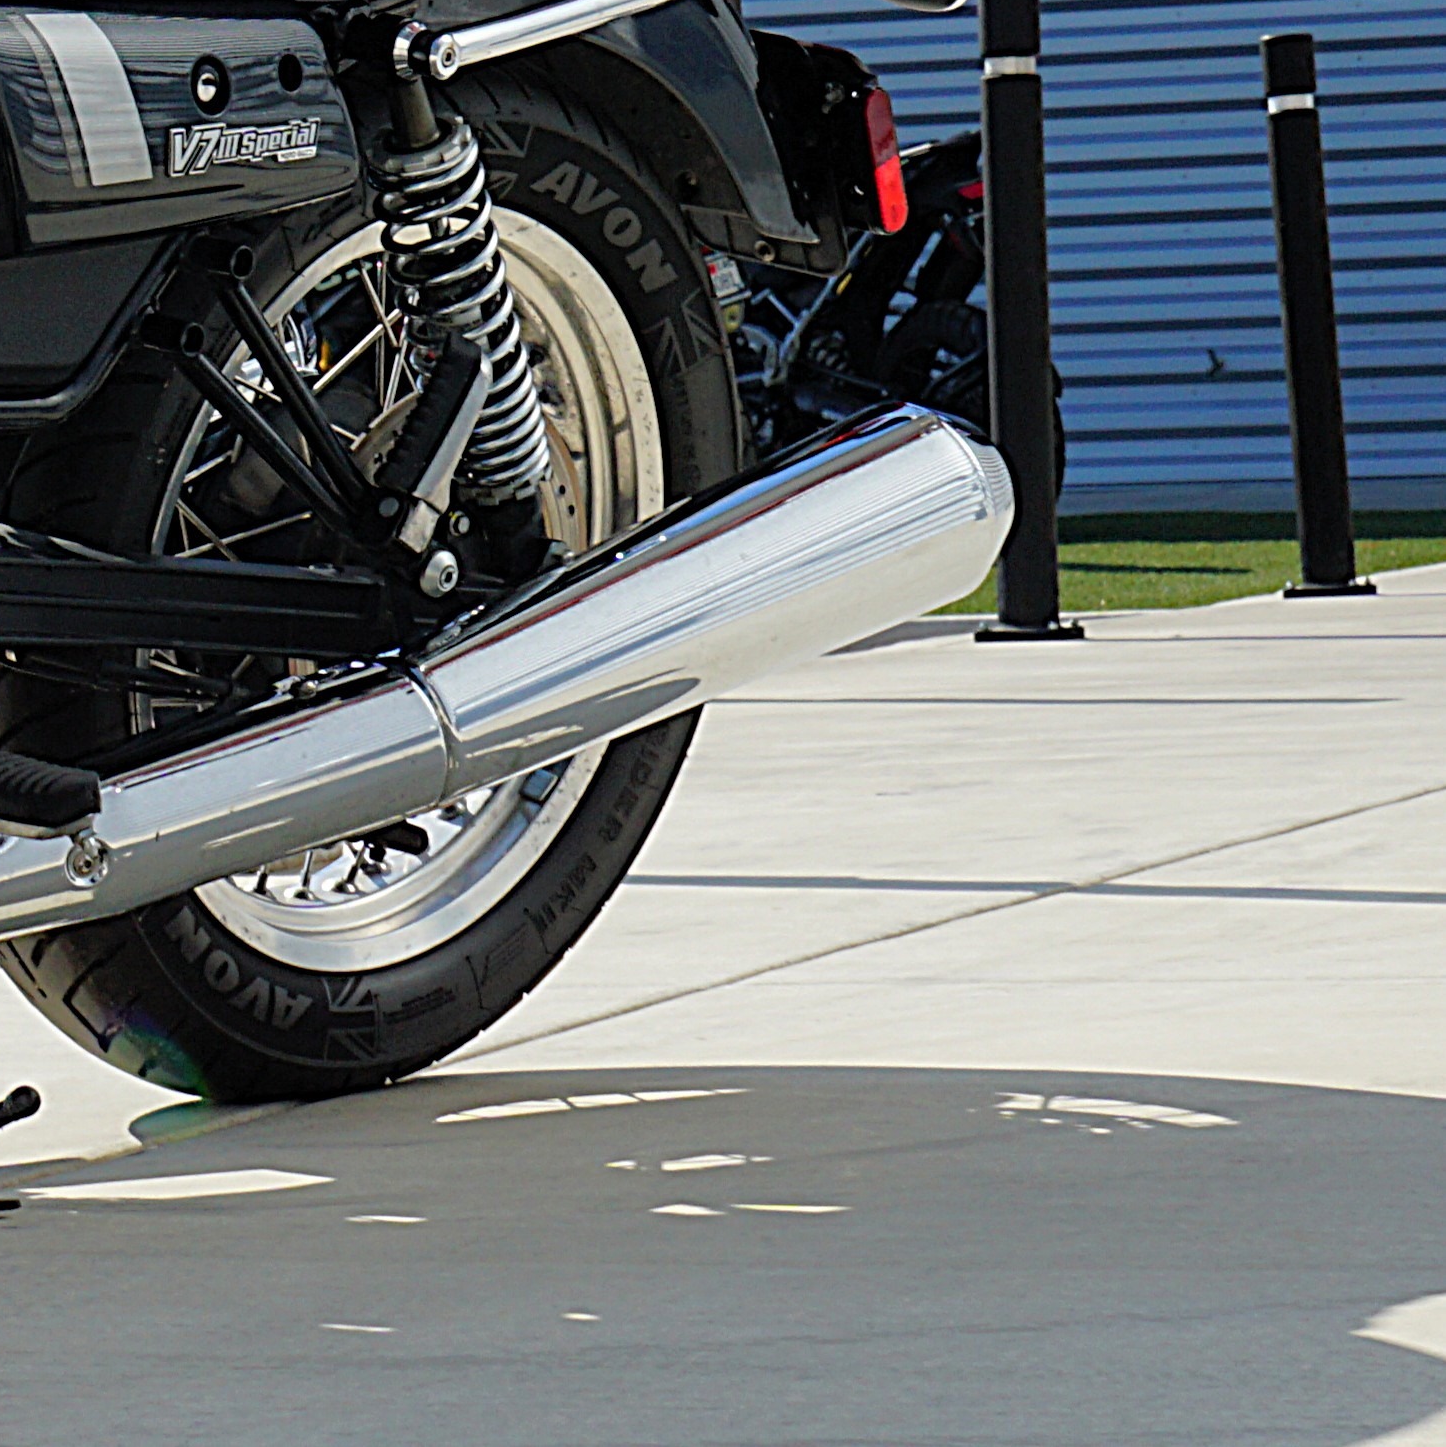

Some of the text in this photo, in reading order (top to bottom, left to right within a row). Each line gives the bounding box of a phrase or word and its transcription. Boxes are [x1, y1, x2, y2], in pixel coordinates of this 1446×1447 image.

[240, 119, 319, 157] Special
[529, 161, 679, 294] AVON
[164, 905, 313, 1030] AVON
